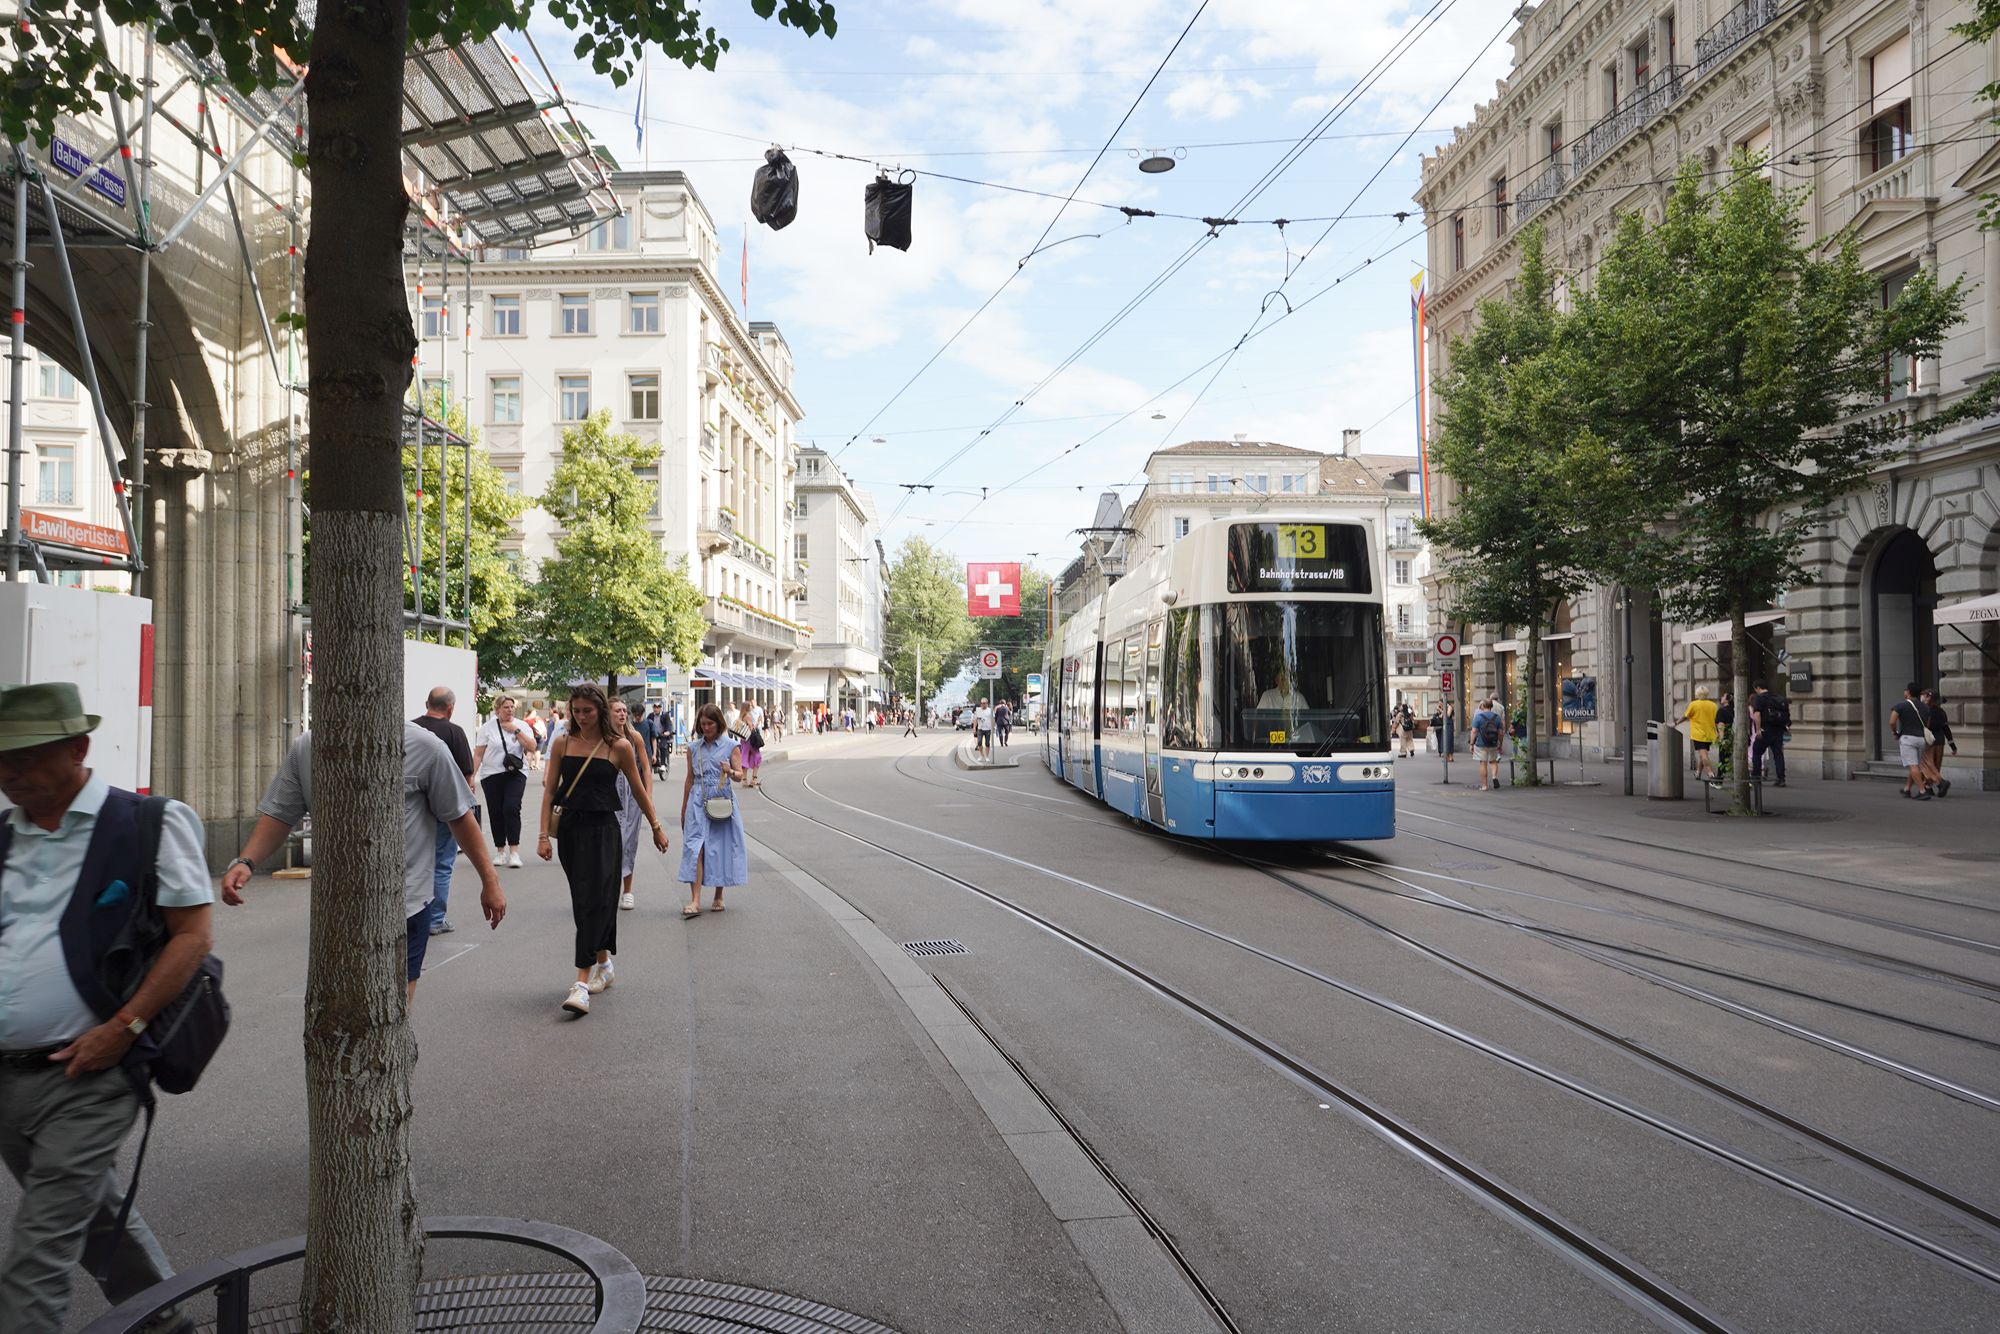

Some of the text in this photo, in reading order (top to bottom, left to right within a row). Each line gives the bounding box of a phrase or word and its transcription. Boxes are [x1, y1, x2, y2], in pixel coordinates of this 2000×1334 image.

[31, 514, 124, 548] Lawilgerüstet.
[1286, 529, 1317, 554] 13
[1260, 568, 1345, 580] Bahnhofstrasse/HB
[1969, 608, 2000, 620] ZEGNA
[1701, 633, 1718, 641] ZEGNA
[1791, 673, 1808, 681] ZEGNA
[1564, 709, 1595, 718] (W)HOLE
